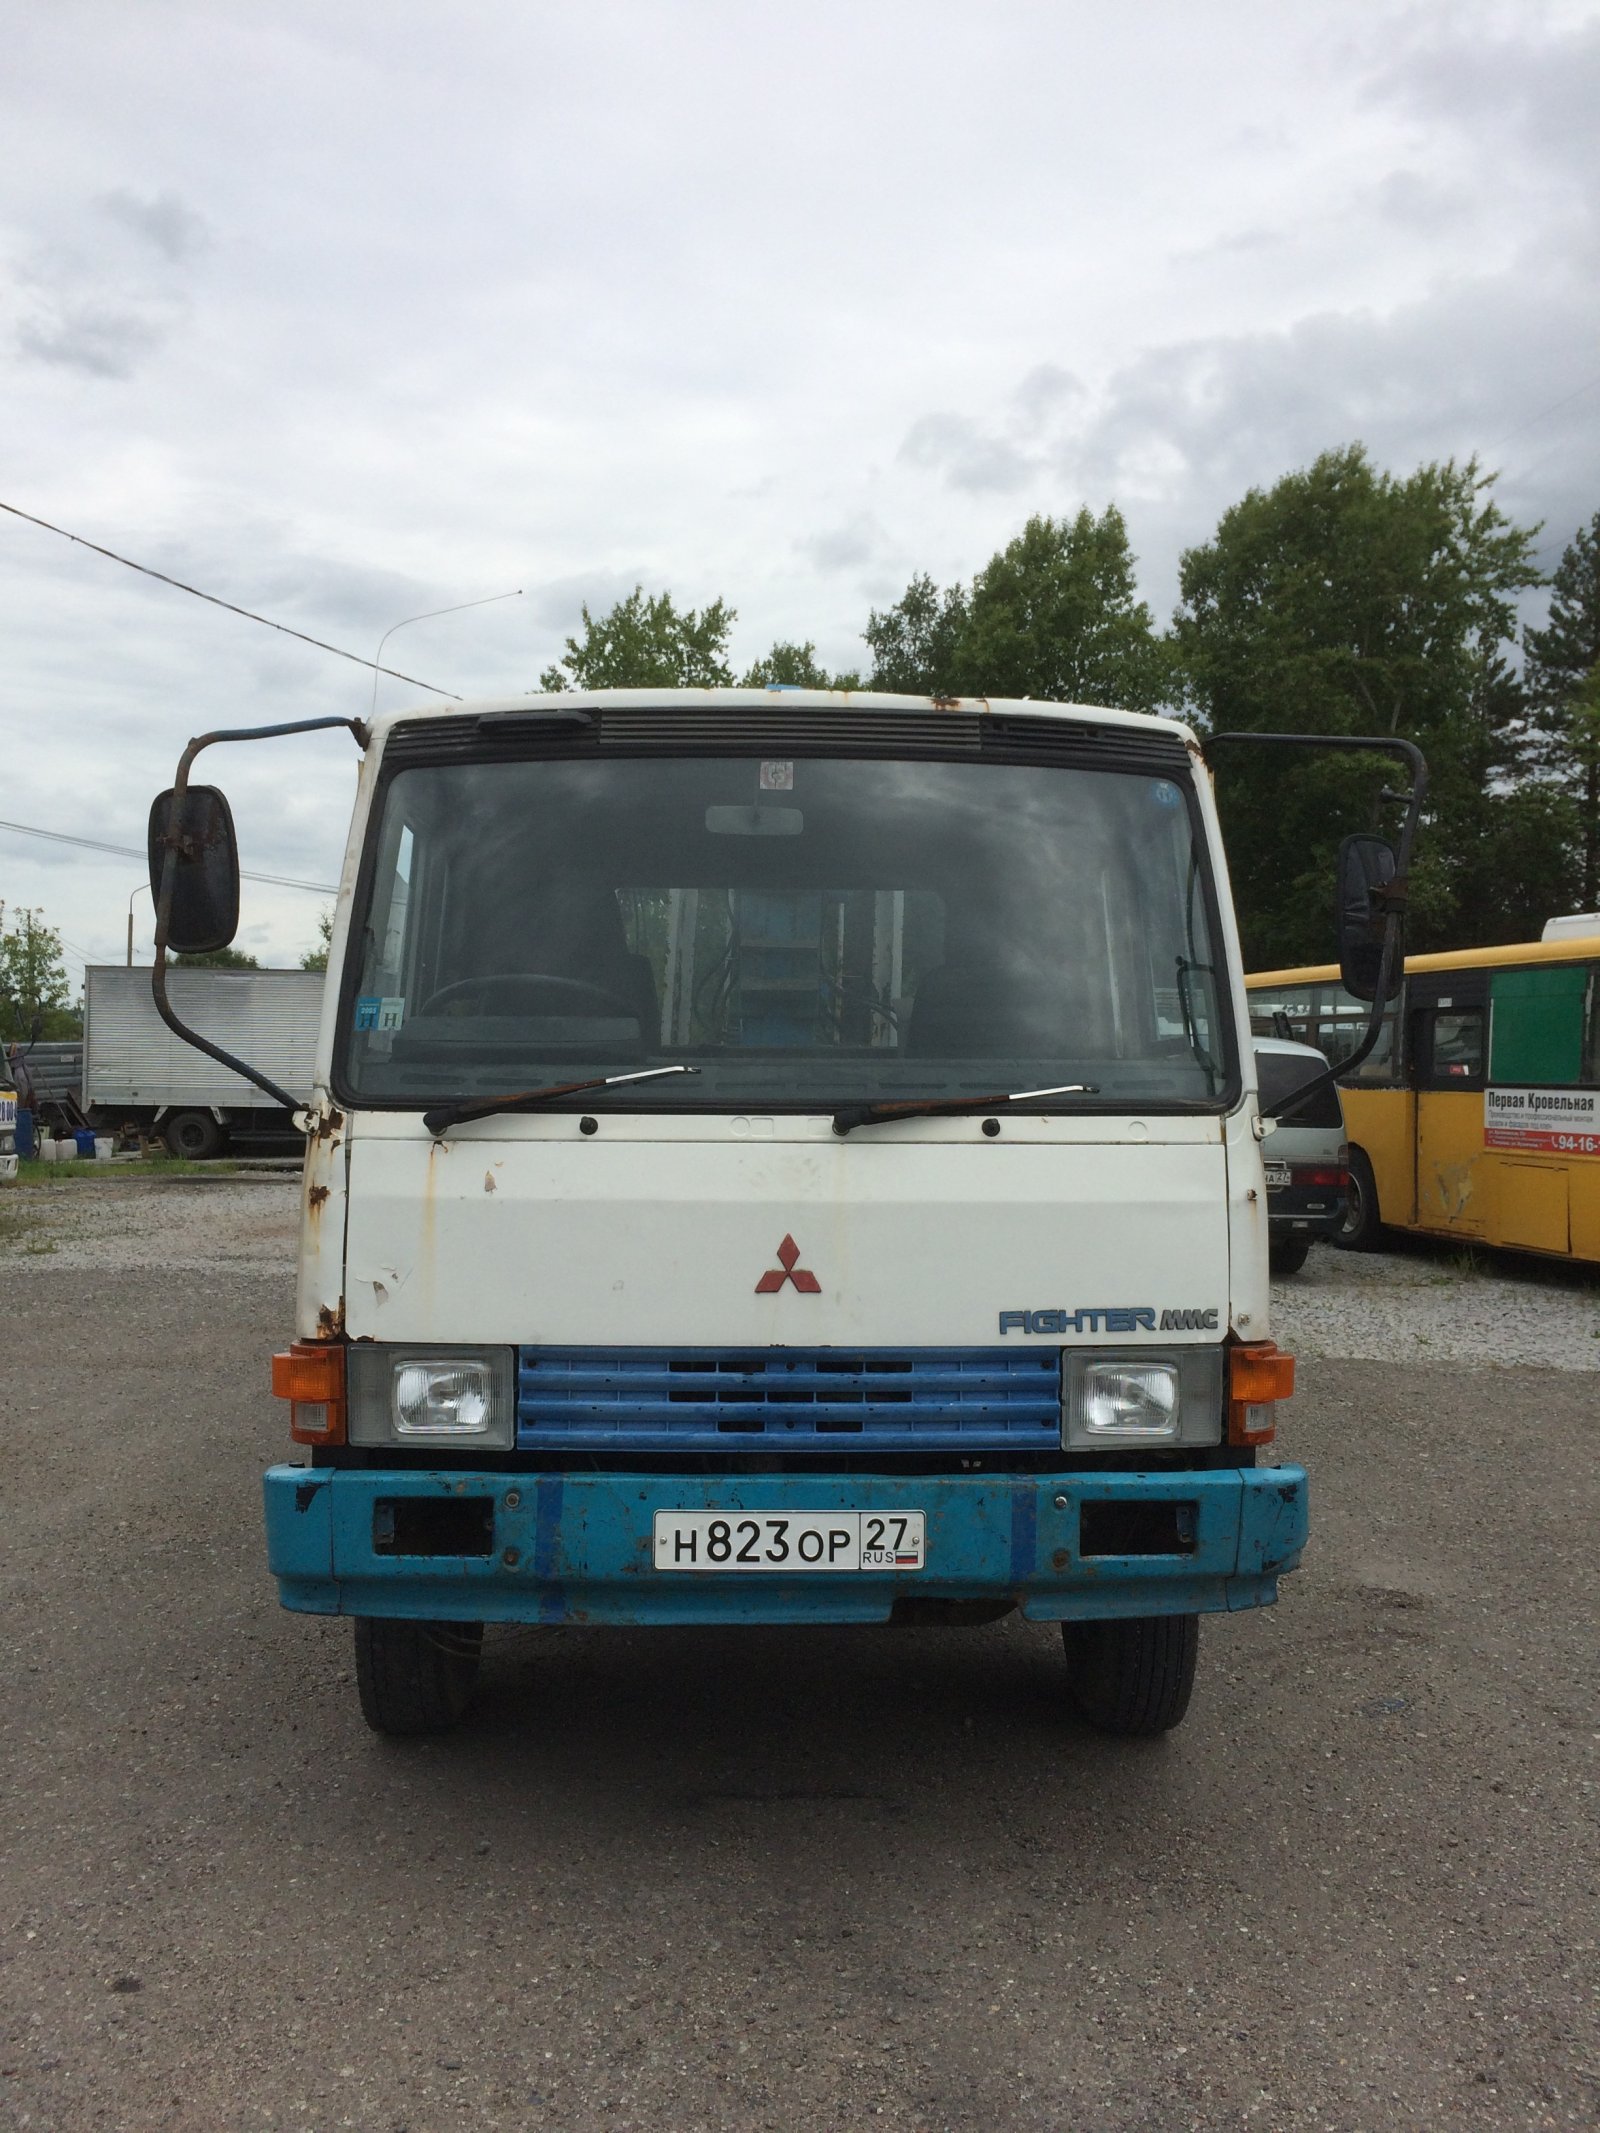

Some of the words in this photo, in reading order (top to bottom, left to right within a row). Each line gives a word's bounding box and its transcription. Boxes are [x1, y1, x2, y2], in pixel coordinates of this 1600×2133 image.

[1488, 1091, 1525, 1111] Первая
[1527, 1092, 1594, 1112] Кровельная
[1558, 1135, 1600, 1152] 94-16-
[999, 1307, 1157, 1335] FIGHTER
[1160, 1308, 1219, 1331] MMC
[866, 1518, 908, 1551] 27
[862, 1552, 894, 1564] RUS
